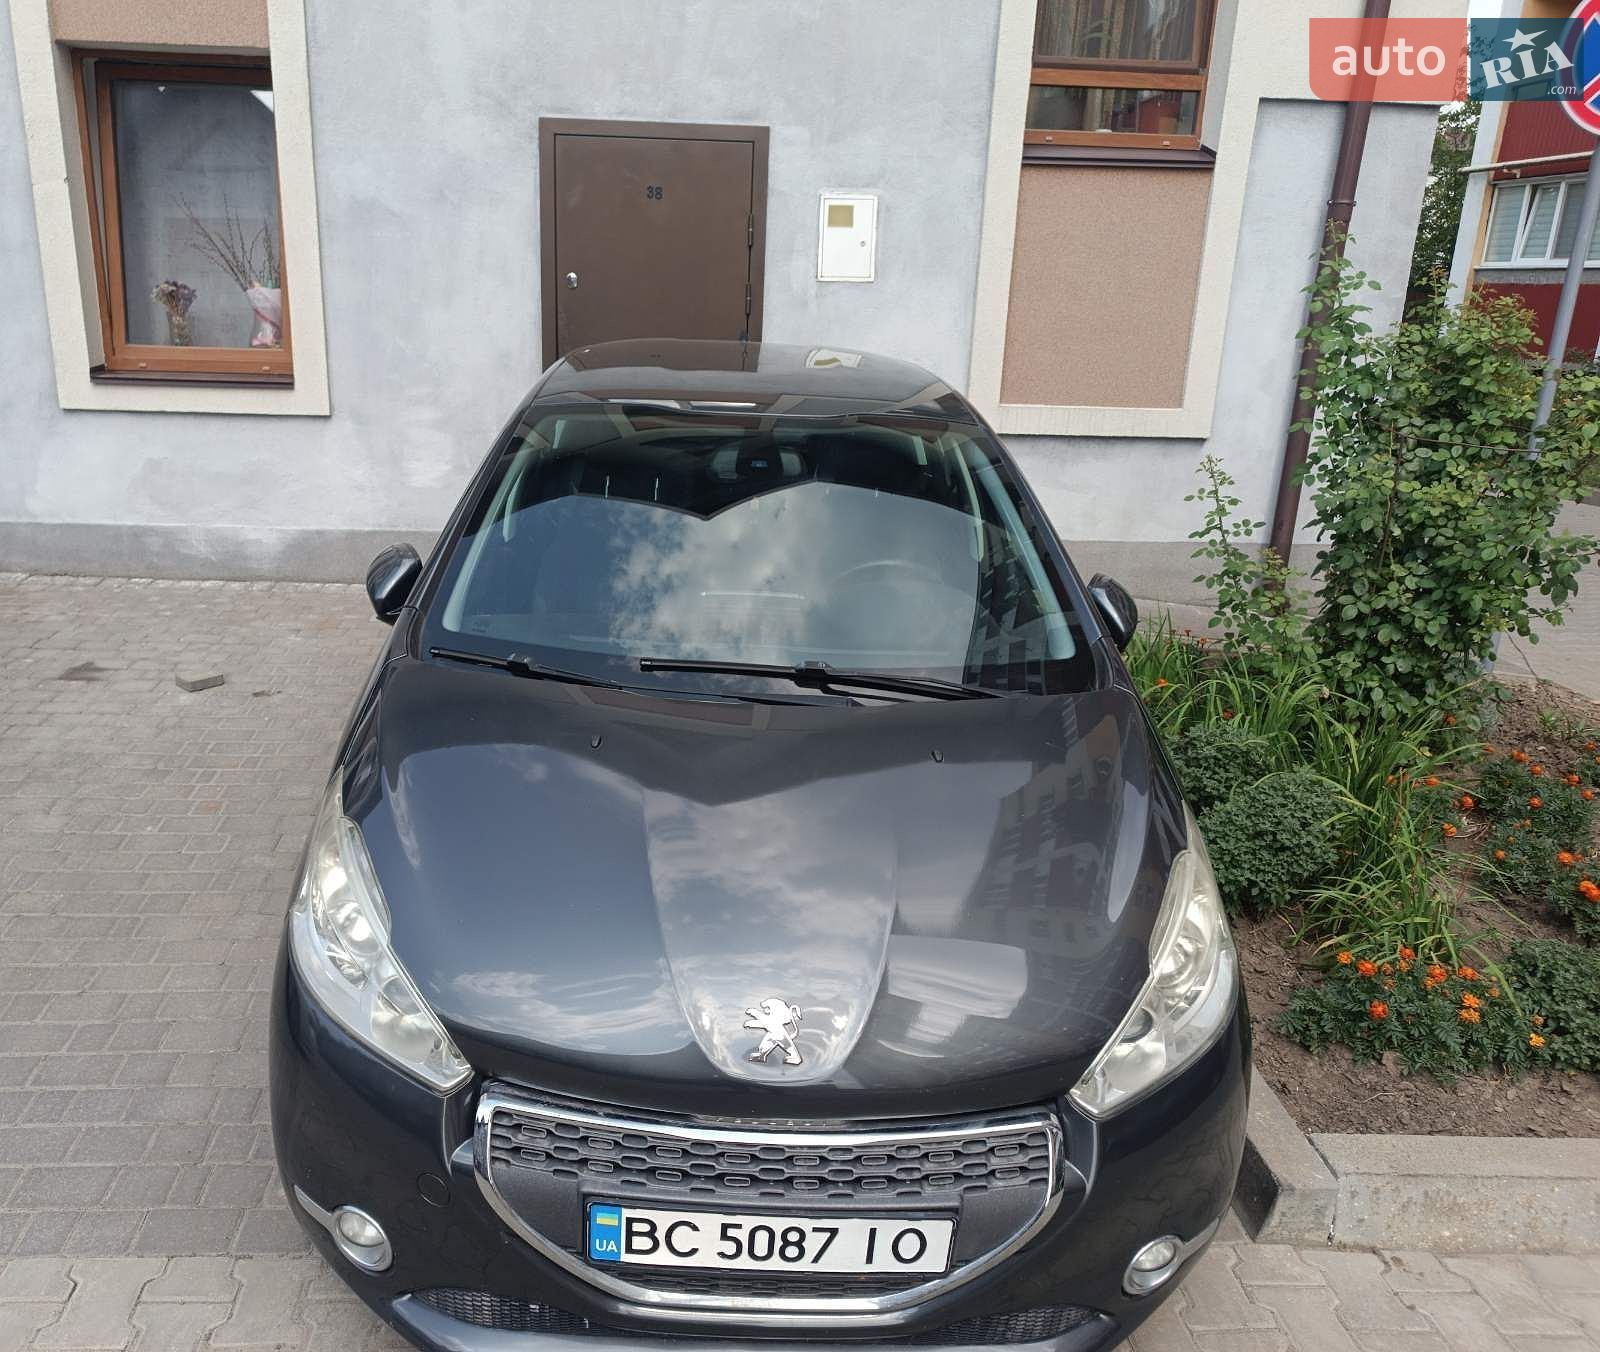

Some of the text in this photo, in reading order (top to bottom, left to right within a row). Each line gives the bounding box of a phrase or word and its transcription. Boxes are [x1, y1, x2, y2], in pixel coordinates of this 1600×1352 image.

[647, 185, 663, 200] 38
[595, 1238, 618, 1253] UA
[624, 1216, 700, 1258] BC
[716, 1223, 840, 1264] 5087
